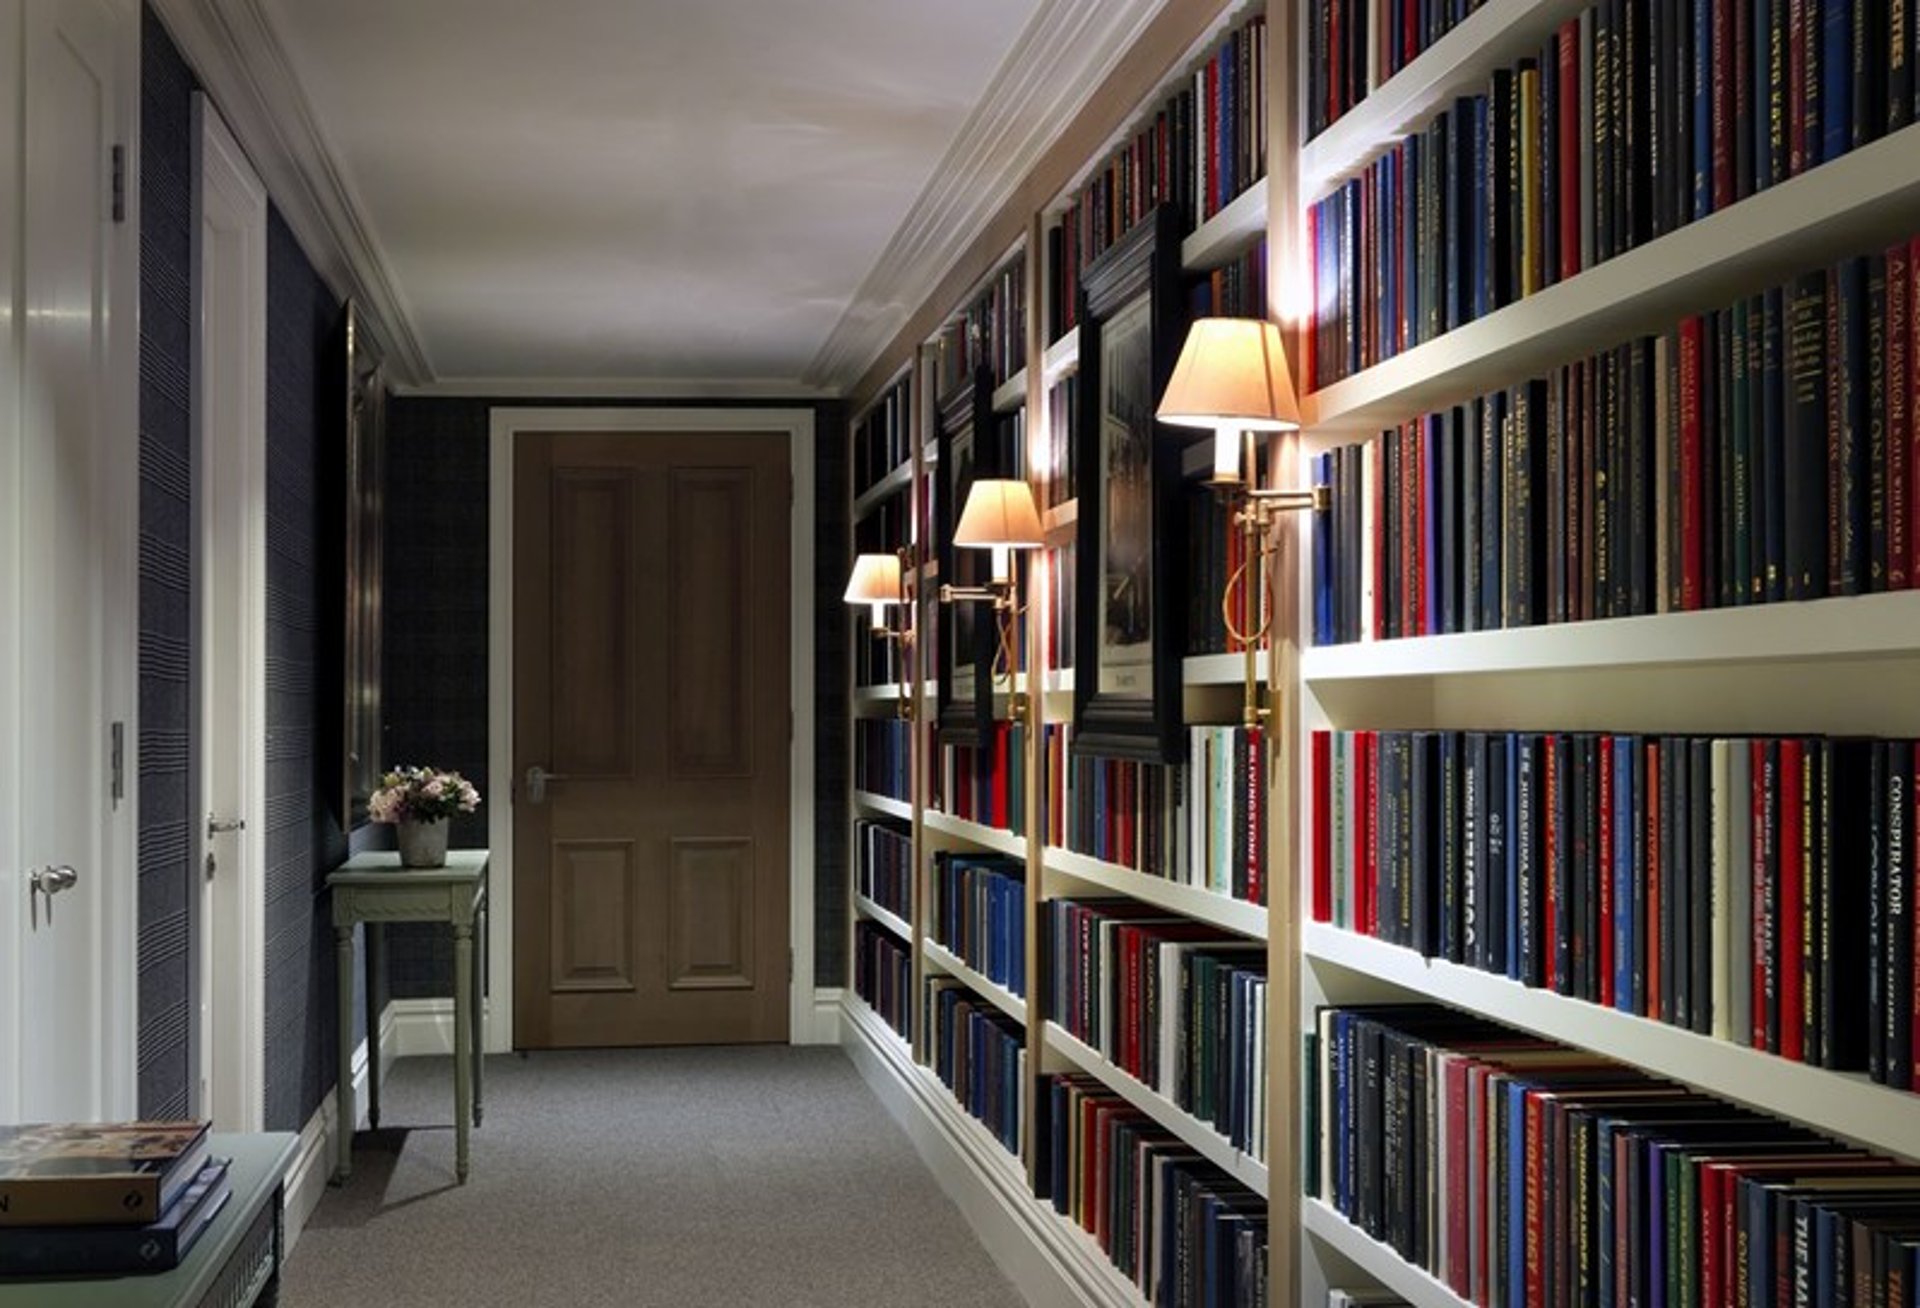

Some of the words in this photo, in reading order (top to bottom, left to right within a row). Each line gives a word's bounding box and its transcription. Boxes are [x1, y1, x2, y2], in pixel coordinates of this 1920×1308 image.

[1891, 342, 1905, 420] PASSION
[1889, 775, 1904, 915] CONSPIRATOR
[1526, 1101, 1540, 1275] ATROCITOLOGY
[1795, 1215, 1809, 1263] THE
